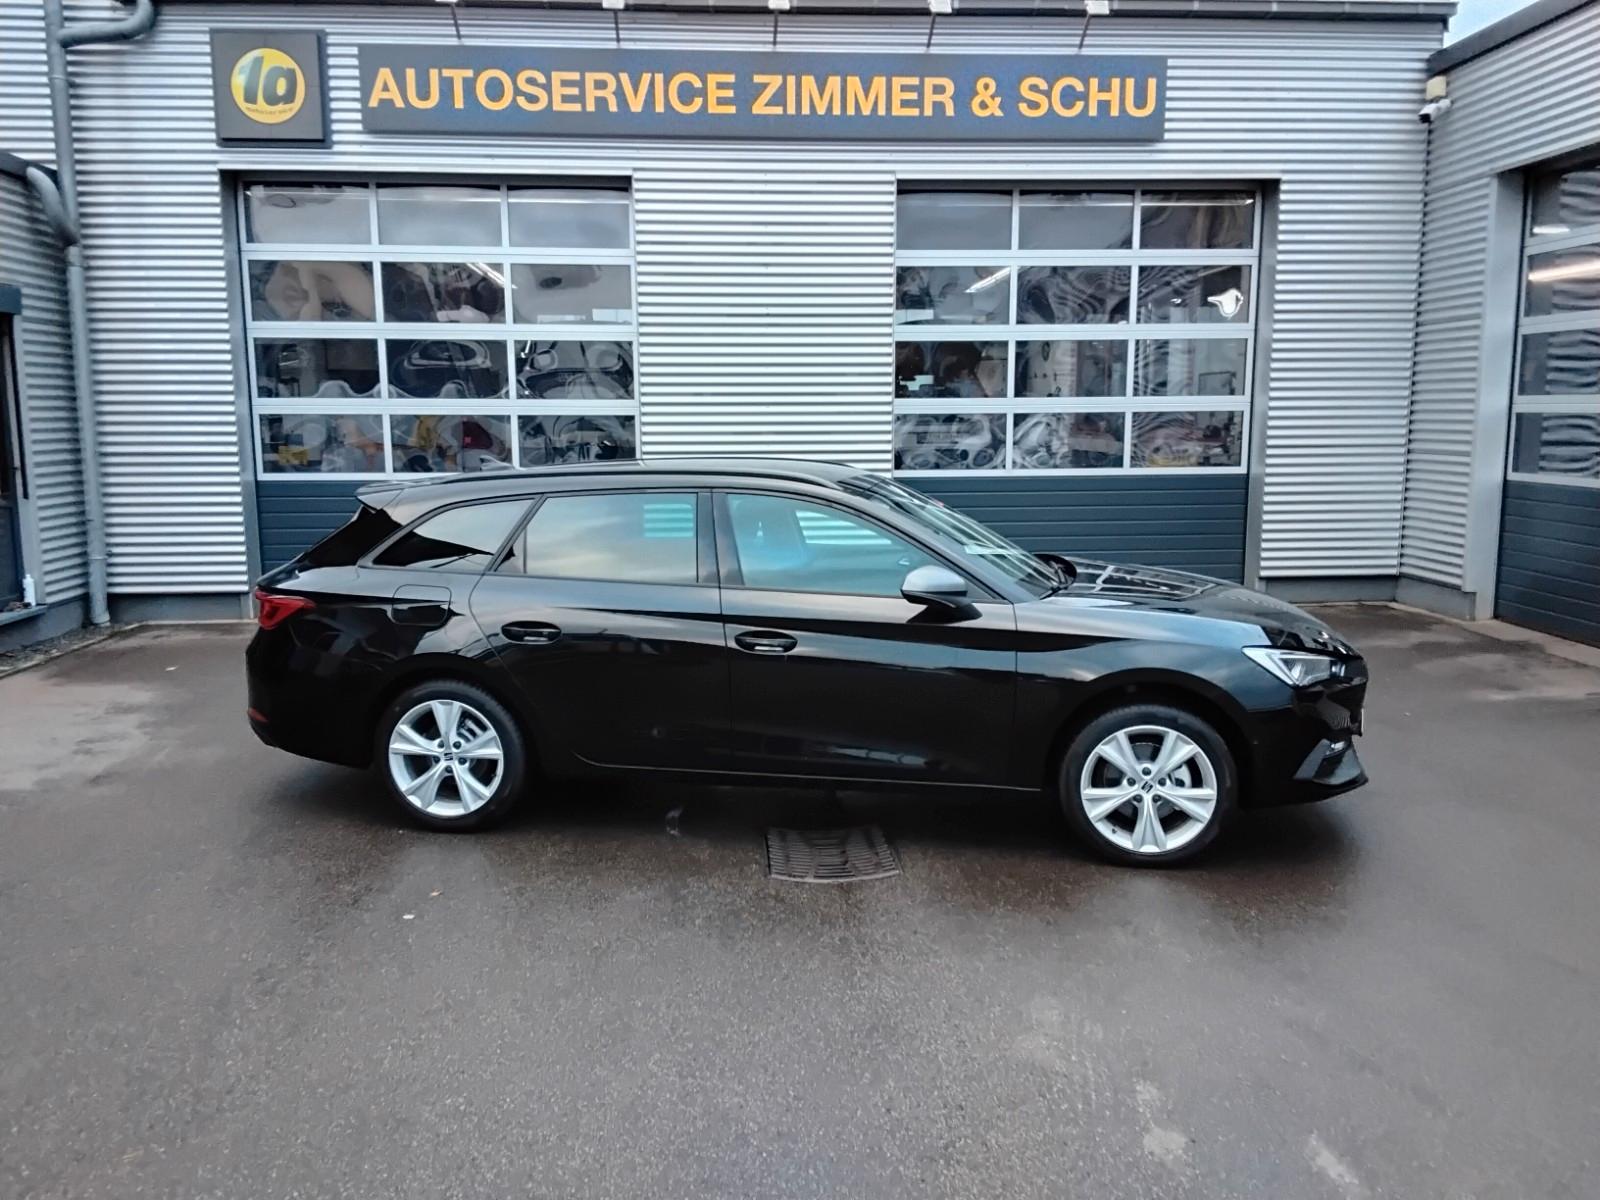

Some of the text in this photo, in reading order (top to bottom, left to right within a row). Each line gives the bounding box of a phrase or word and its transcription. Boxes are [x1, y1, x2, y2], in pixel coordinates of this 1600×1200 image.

[238, 56, 298, 107] 1a
[368, 67, 1157, 117] AUTOSERVICE ZIMMER & SCHU
